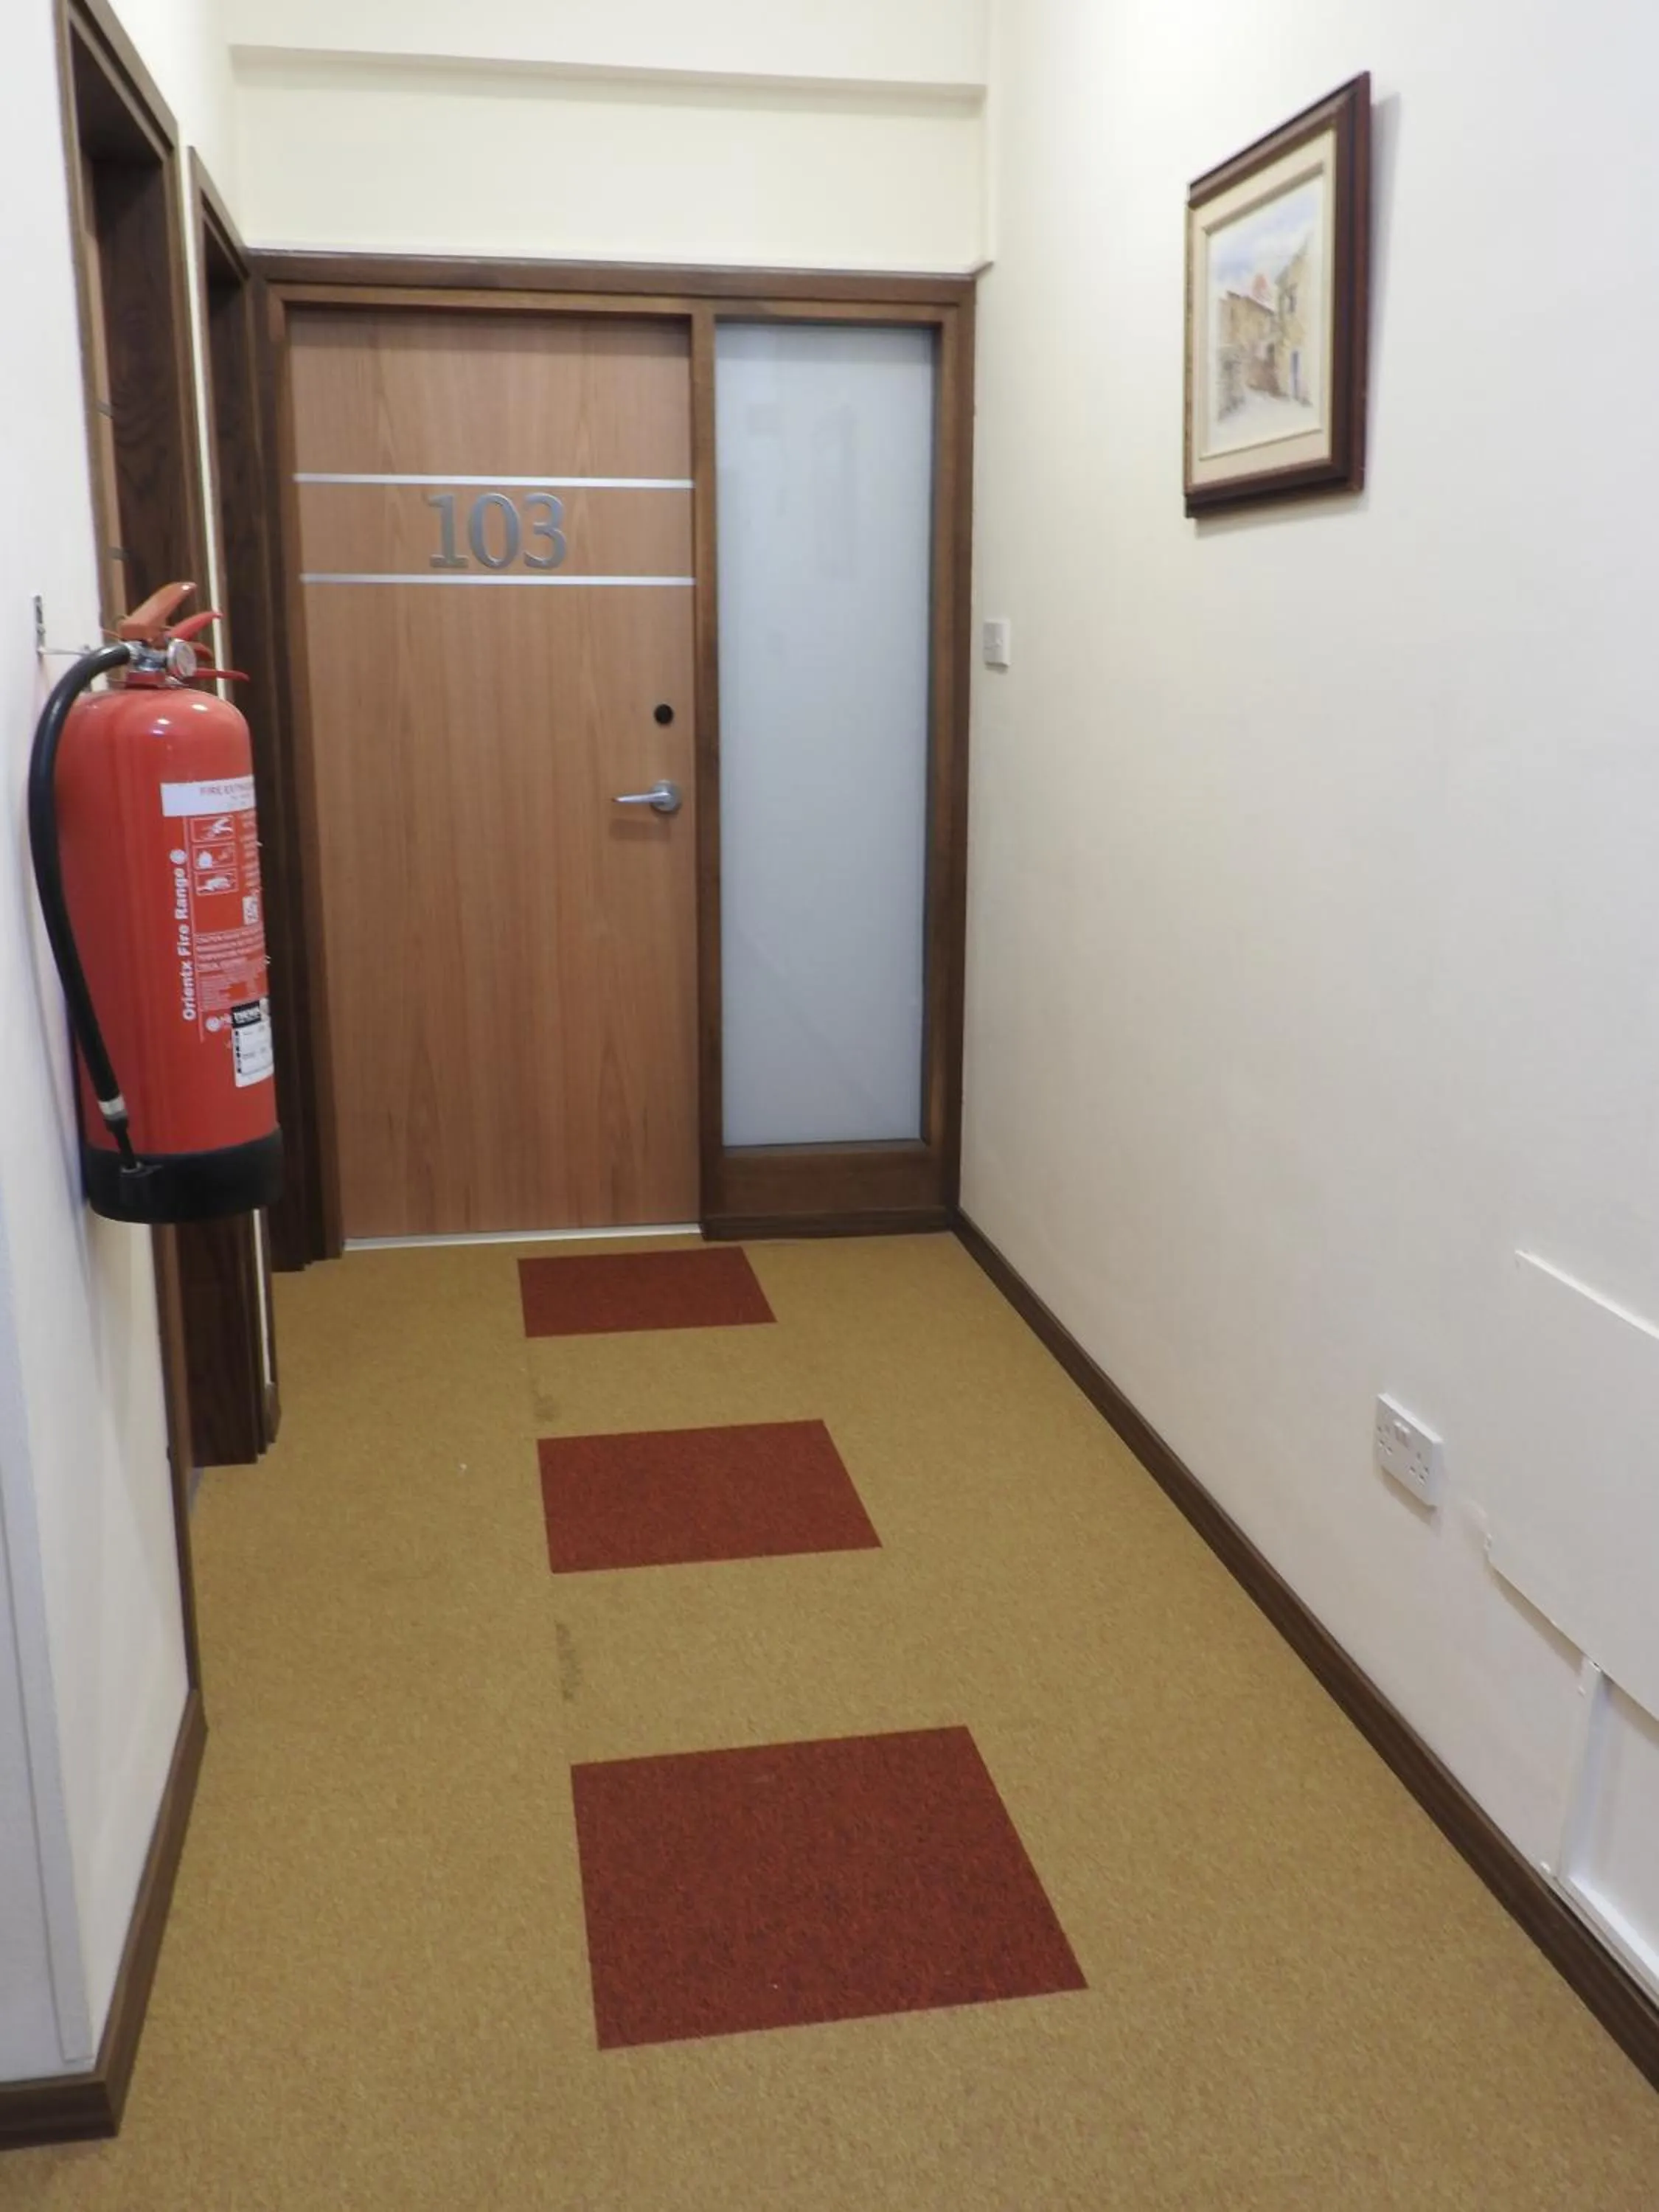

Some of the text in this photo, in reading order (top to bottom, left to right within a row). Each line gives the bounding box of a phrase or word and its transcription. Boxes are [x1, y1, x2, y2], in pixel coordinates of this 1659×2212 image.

[428, 493, 567, 569] 103
[174, 868, 189, 919] Range
[177, 924, 191, 956] Fire
